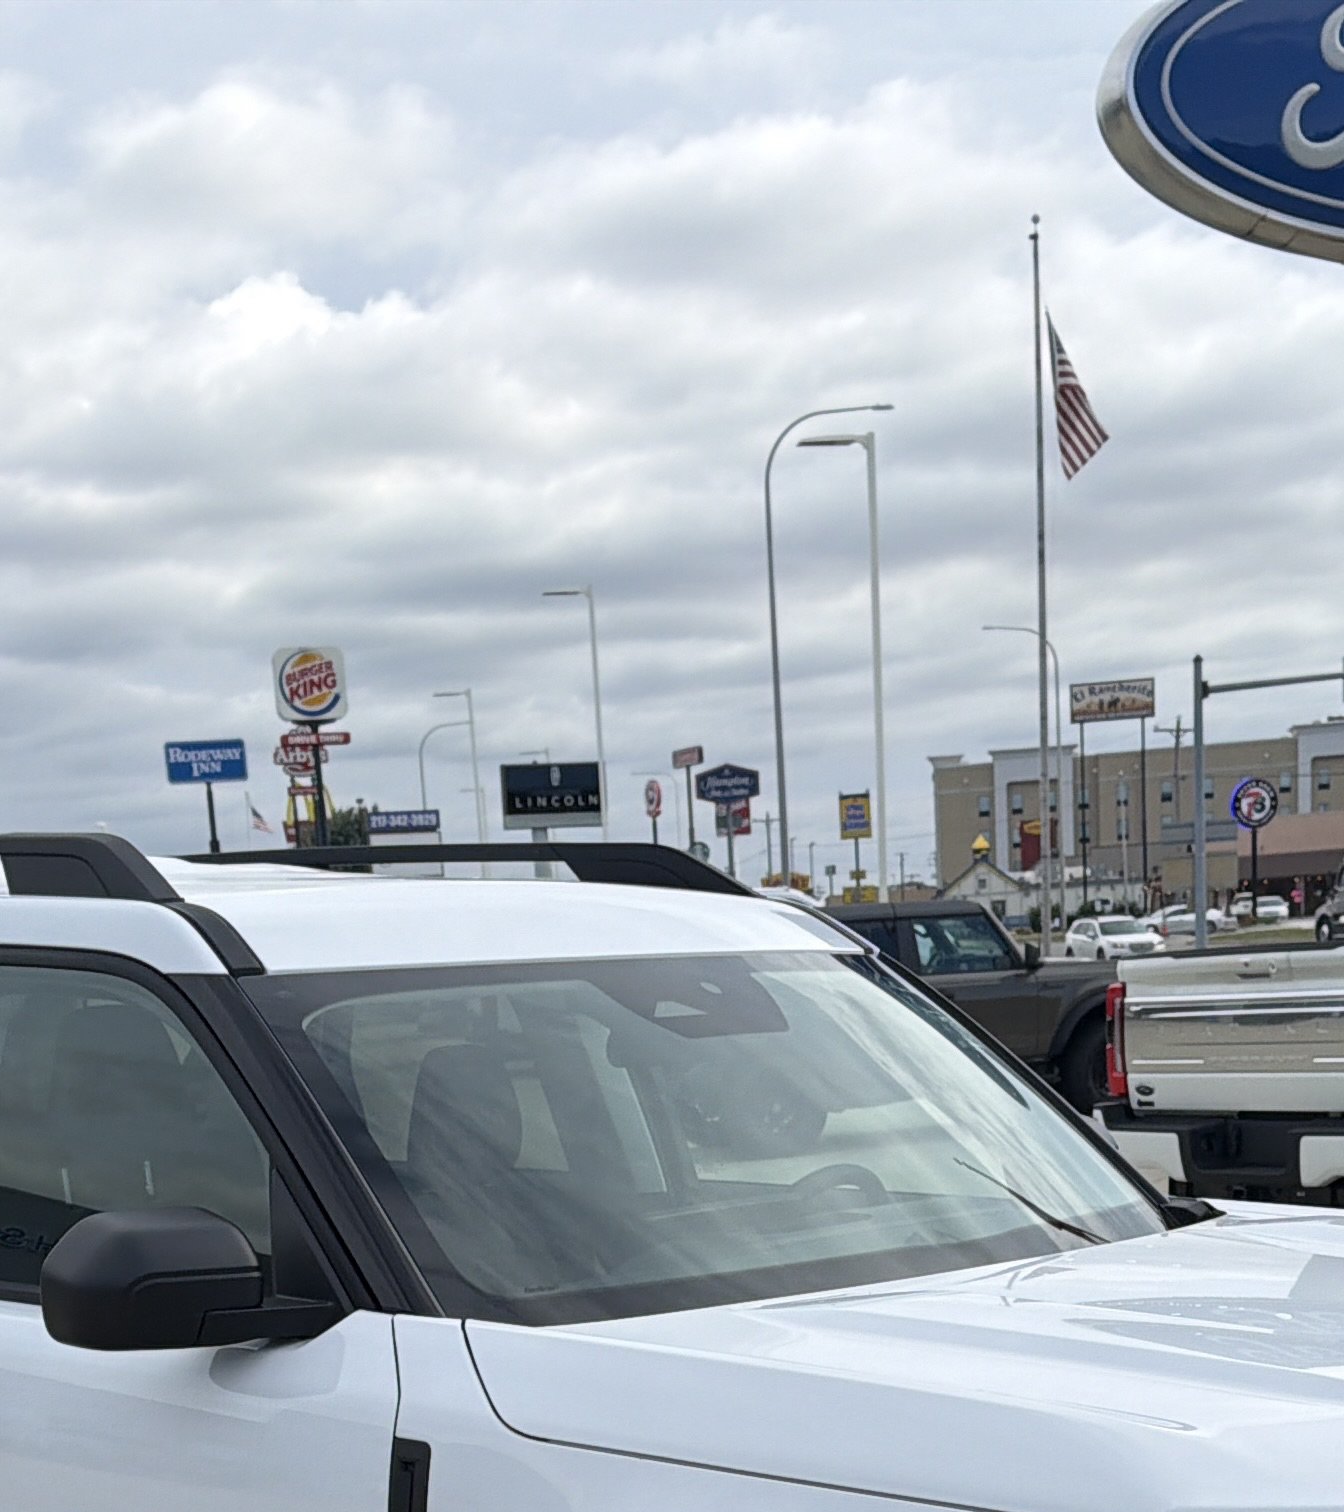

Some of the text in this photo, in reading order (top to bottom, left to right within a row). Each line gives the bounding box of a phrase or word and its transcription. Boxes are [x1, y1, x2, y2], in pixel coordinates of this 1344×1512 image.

[285, 661, 335, 686] BURGER
[290, 673, 337, 703] KING
[276, 746, 328, 767] Arbys
[192, 762, 223, 777] INN
[515, 794, 598, 808] LINCOLN
